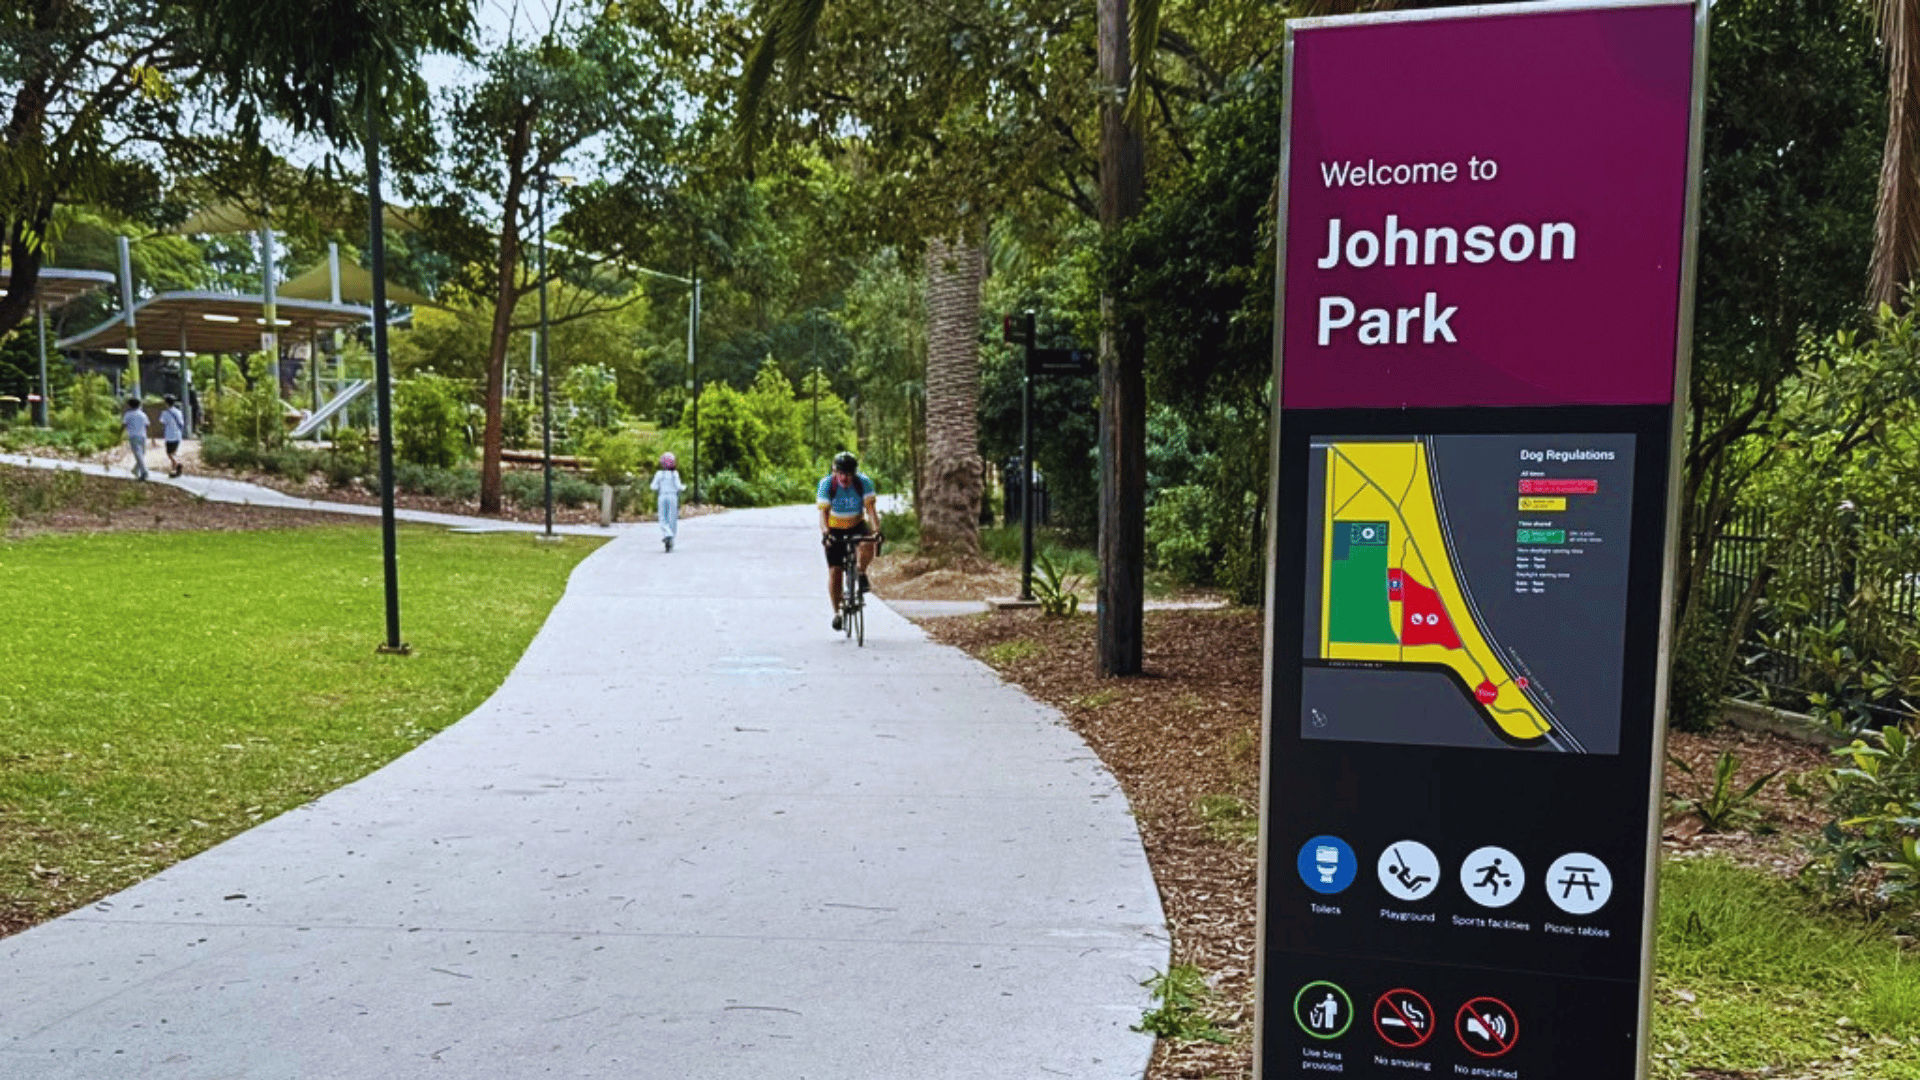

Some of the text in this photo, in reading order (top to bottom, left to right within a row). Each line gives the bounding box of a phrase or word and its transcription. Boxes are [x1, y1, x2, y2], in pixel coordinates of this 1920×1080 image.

[1320, 155, 1498, 188] Welcome to
[1317, 214, 1576, 270] Johnson
[1317, 292, 1459, 346] Park
[1520, 449, 1615, 462] Dog Regulations
[1310, 903, 1342, 914] Toilets
[1380, 908, 1436, 922] Playground
[1452, 914, 1531, 931] Sports facilities
[1544, 922, 1611, 938] Picnic tables
[1302, 1048, 1342, 1061] Use bins
[1302, 1060, 1344, 1072] provided
[1373, 1055, 1432, 1071] No smoking
[1454, 1064, 1518, 1079] No amplified
